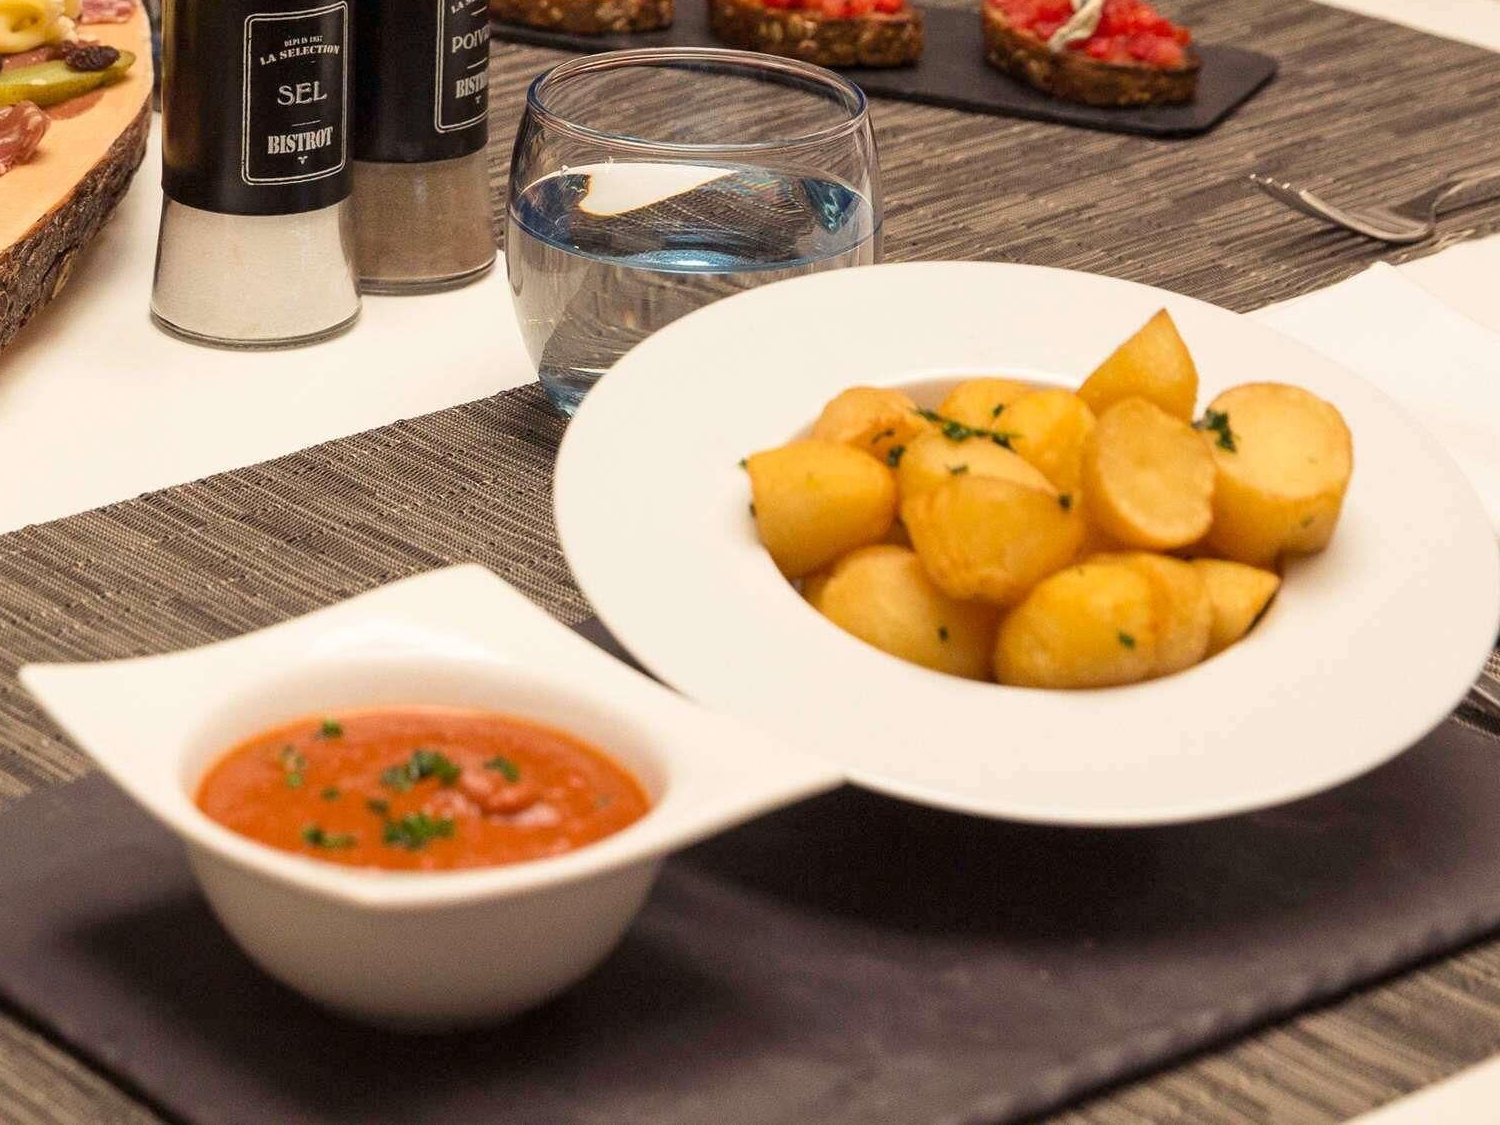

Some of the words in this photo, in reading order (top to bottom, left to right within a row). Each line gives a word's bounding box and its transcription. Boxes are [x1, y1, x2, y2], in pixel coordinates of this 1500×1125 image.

[260, 54, 277, 65] LA
[279, 44, 340, 61] SELECTION
[277, 80, 327, 106] SEL
[267, 126, 334, 154] BISTROT
